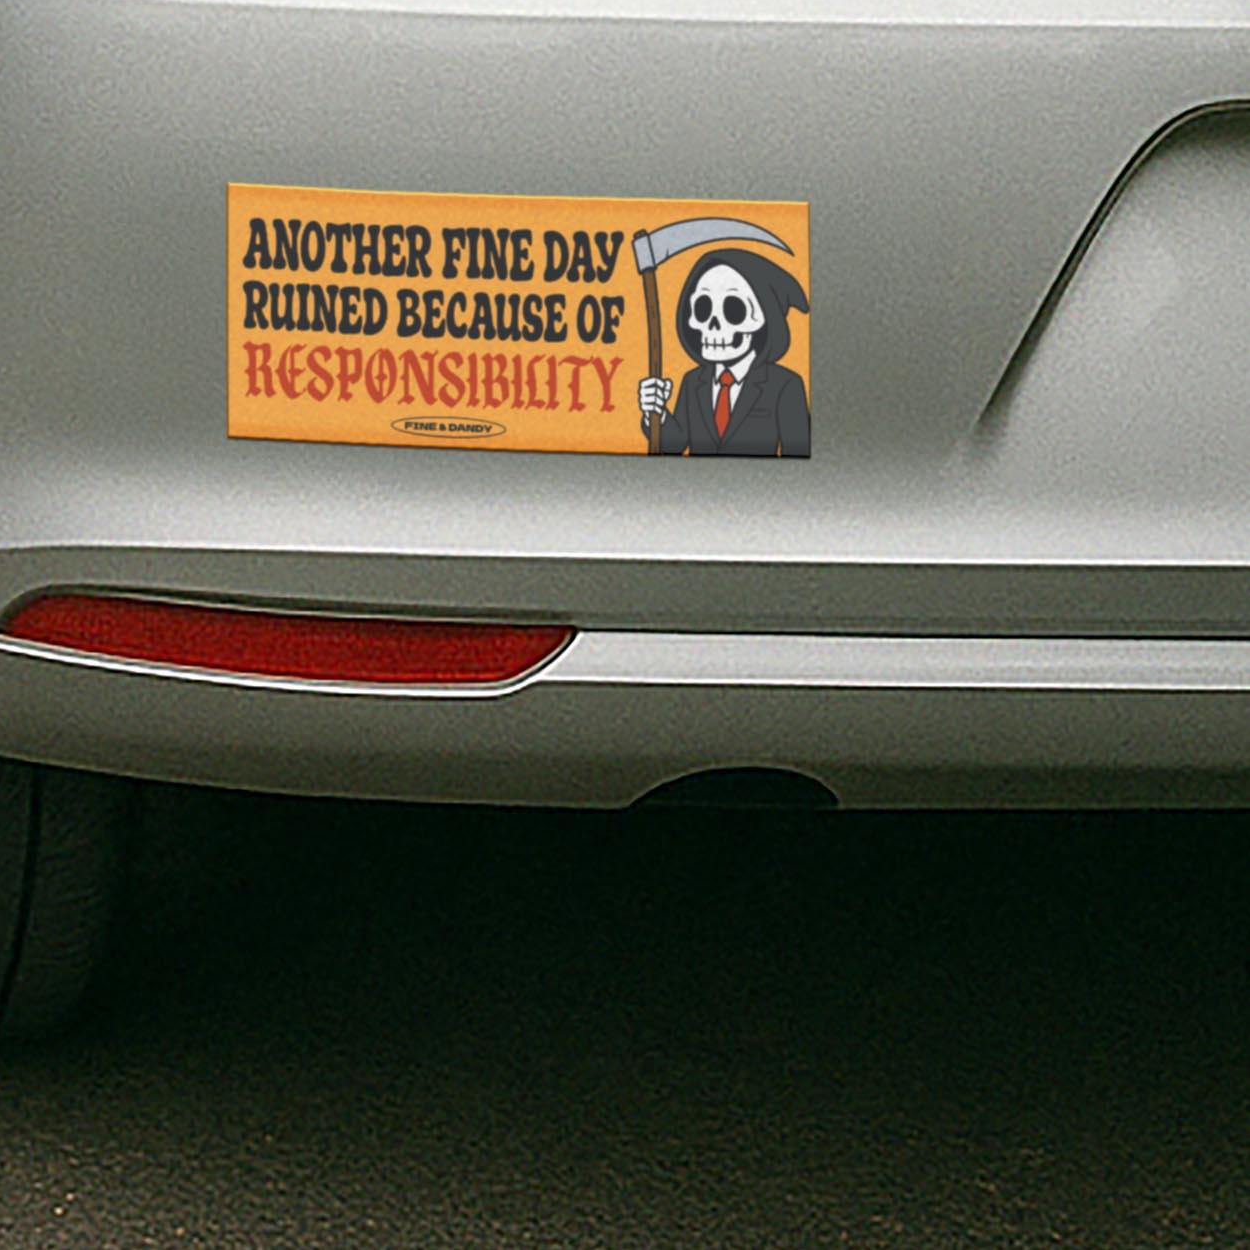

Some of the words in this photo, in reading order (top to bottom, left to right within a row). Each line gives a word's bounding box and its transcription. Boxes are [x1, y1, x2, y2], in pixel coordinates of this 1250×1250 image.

[242, 218, 432, 278] ANOTHER
[441, 227, 534, 281] FINE
[543, 230, 624, 283] DAY
[243, 280, 387, 335] RUINED
[396, 288, 567, 342] BECAUSE
[576, 295, 624, 344] OF
[242, 341, 623, 412] RESPONSIBILITY
[404, 421, 438, 431] FINE
[448, 423, 493, 433] DANDY
